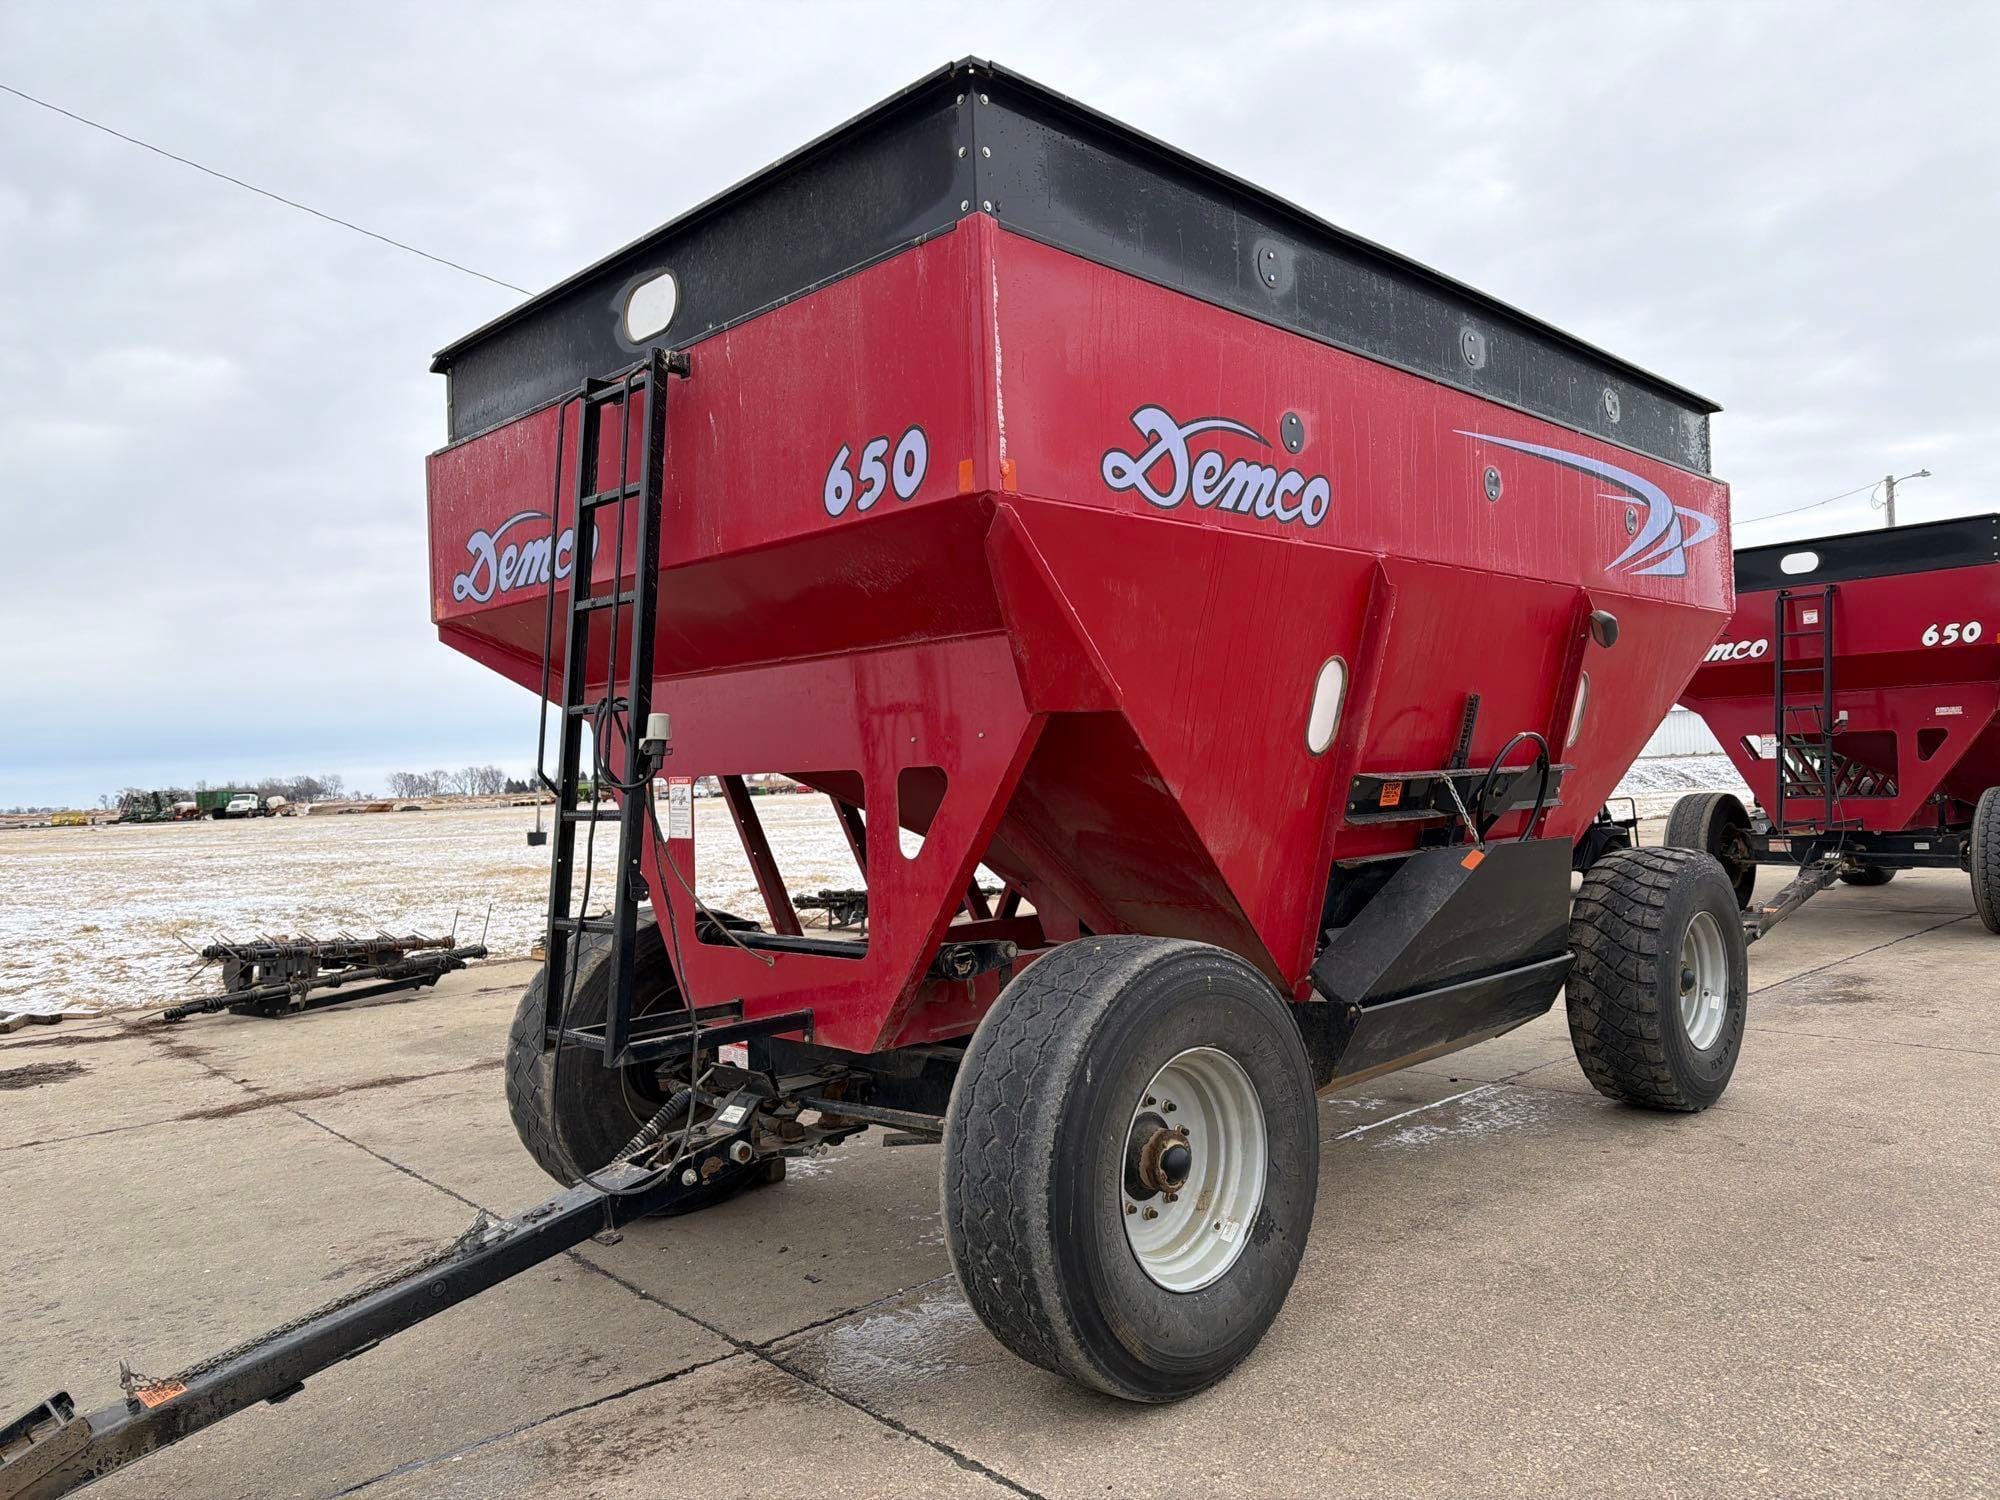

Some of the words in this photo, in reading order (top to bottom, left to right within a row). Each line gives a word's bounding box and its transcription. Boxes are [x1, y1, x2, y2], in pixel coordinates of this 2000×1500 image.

[823, 424, 929, 518] 650
[1100, 404, 1331, 528] Demco
[452, 510, 600, 603] Demc
[1702, 638, 1769, 662] mco
[1921, 619, 1983, 647] 650
